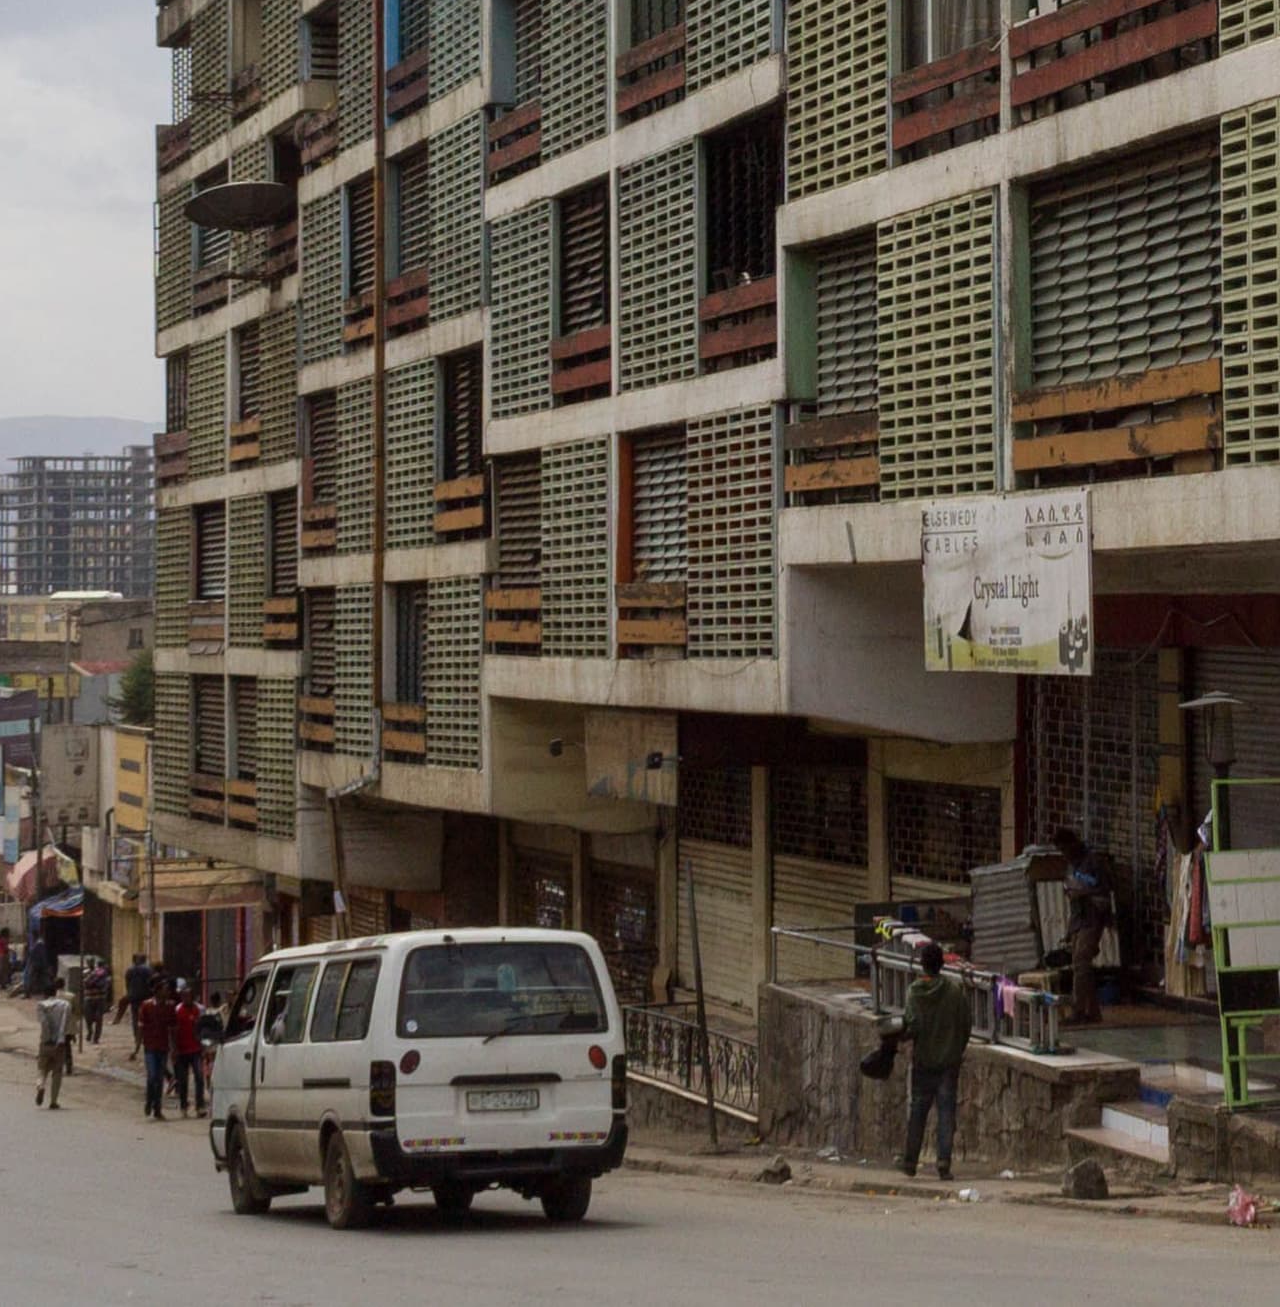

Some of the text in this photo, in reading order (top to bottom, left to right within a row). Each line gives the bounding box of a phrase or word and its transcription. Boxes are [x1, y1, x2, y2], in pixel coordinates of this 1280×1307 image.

[921, 508, 977, 528] ELSEWEDY
[923, 535, 979, 555] CABLES
[973, 574, 1040, 608] Crystal Light
